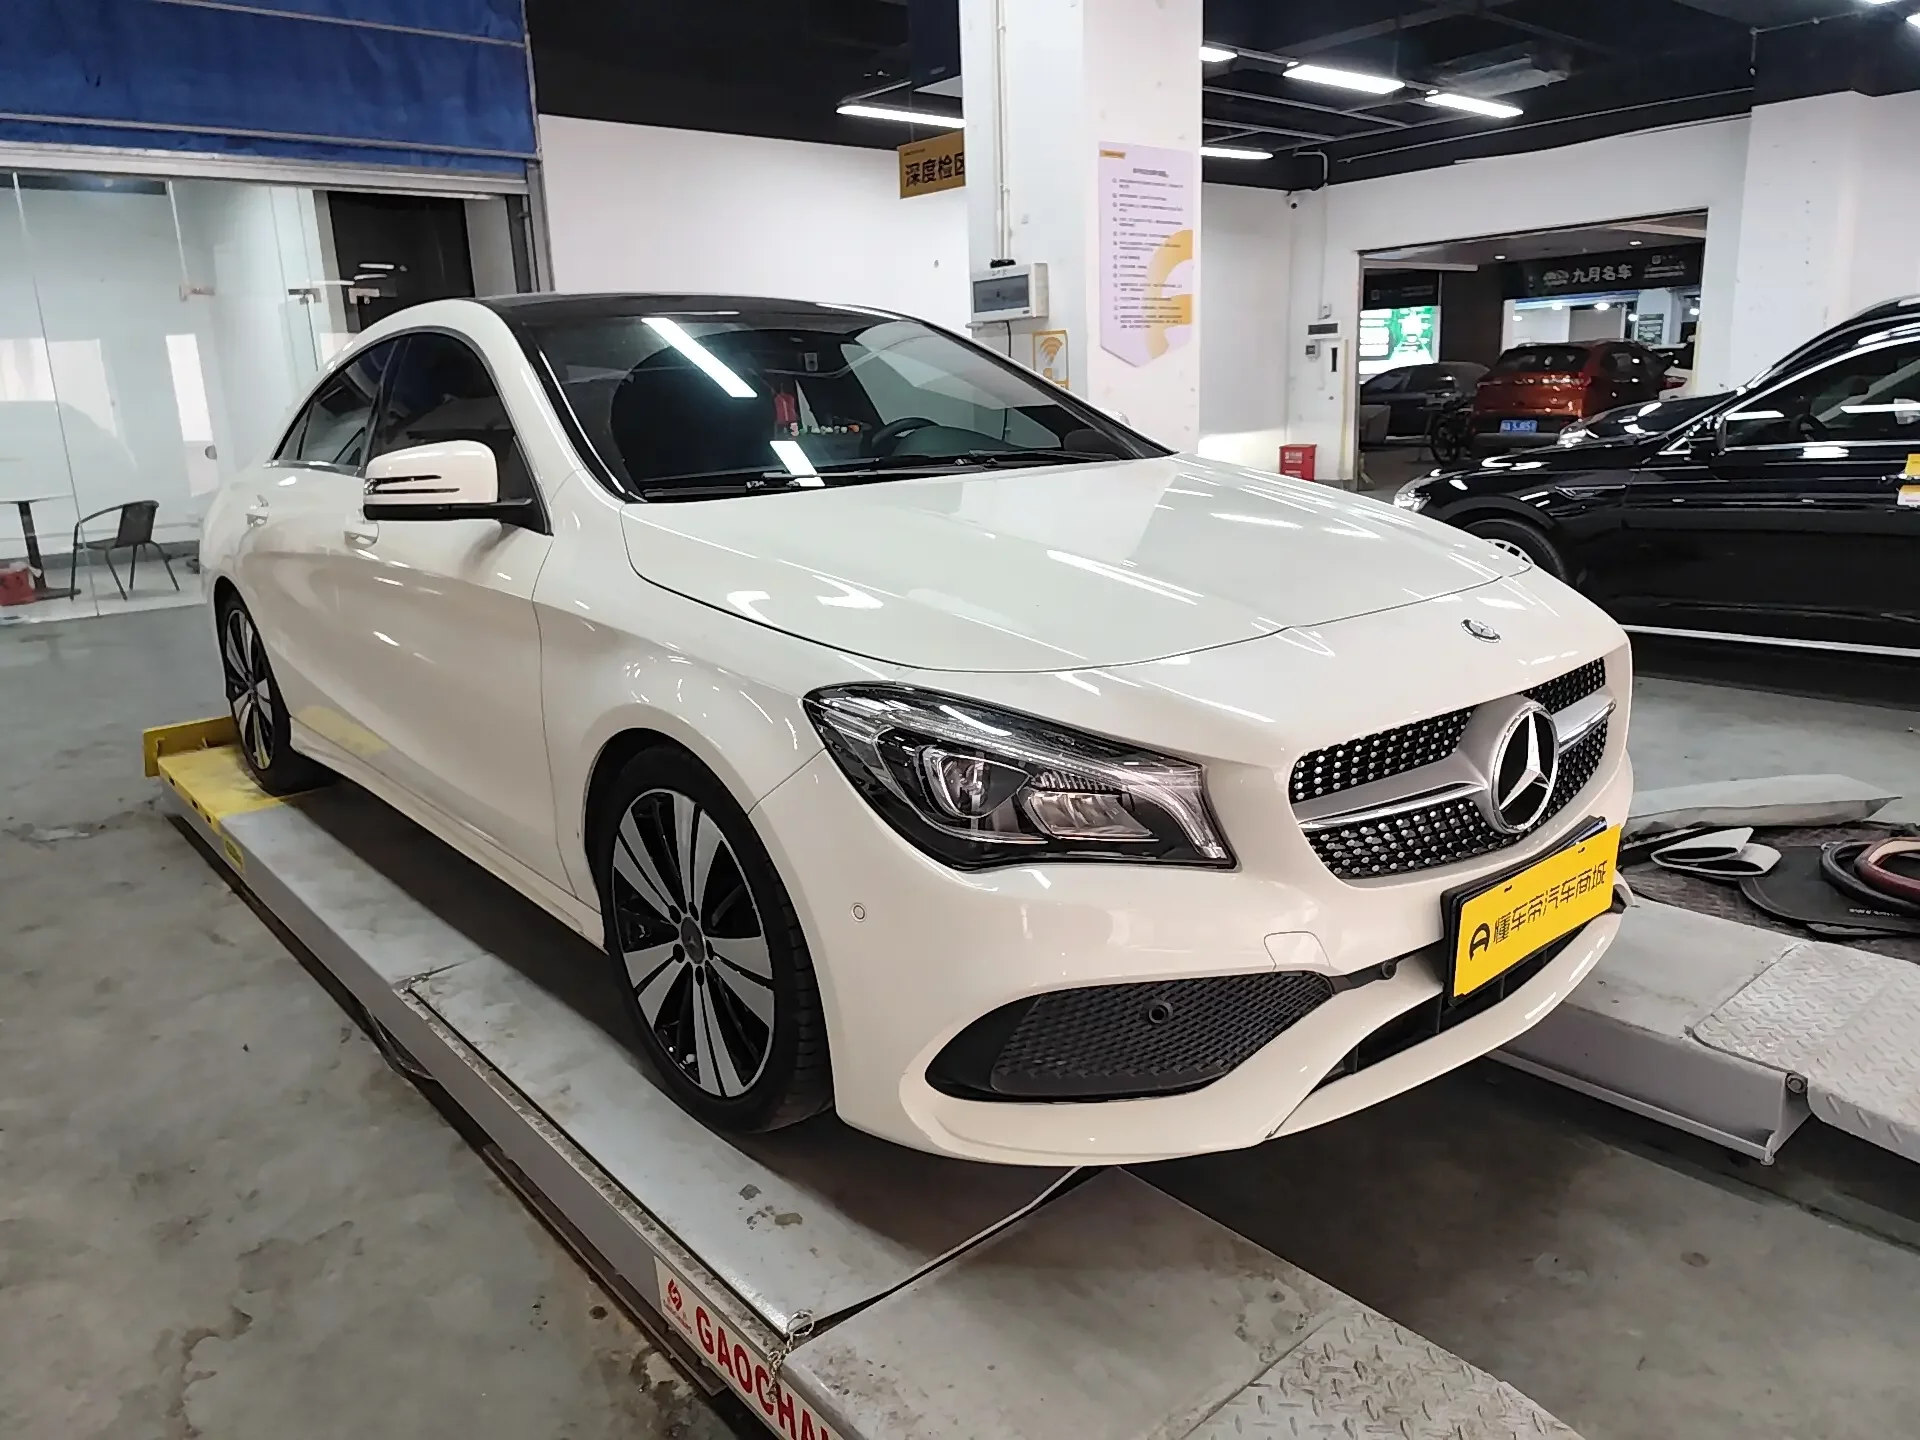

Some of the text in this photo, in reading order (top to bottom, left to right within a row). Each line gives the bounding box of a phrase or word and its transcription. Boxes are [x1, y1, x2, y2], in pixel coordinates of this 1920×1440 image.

[1572, 264, 1633, 283] 九月名车
[1493, 860, 1608, 945] 懂车帝汽车商城
[696, 1305, 829, 1440] GAOCHA
